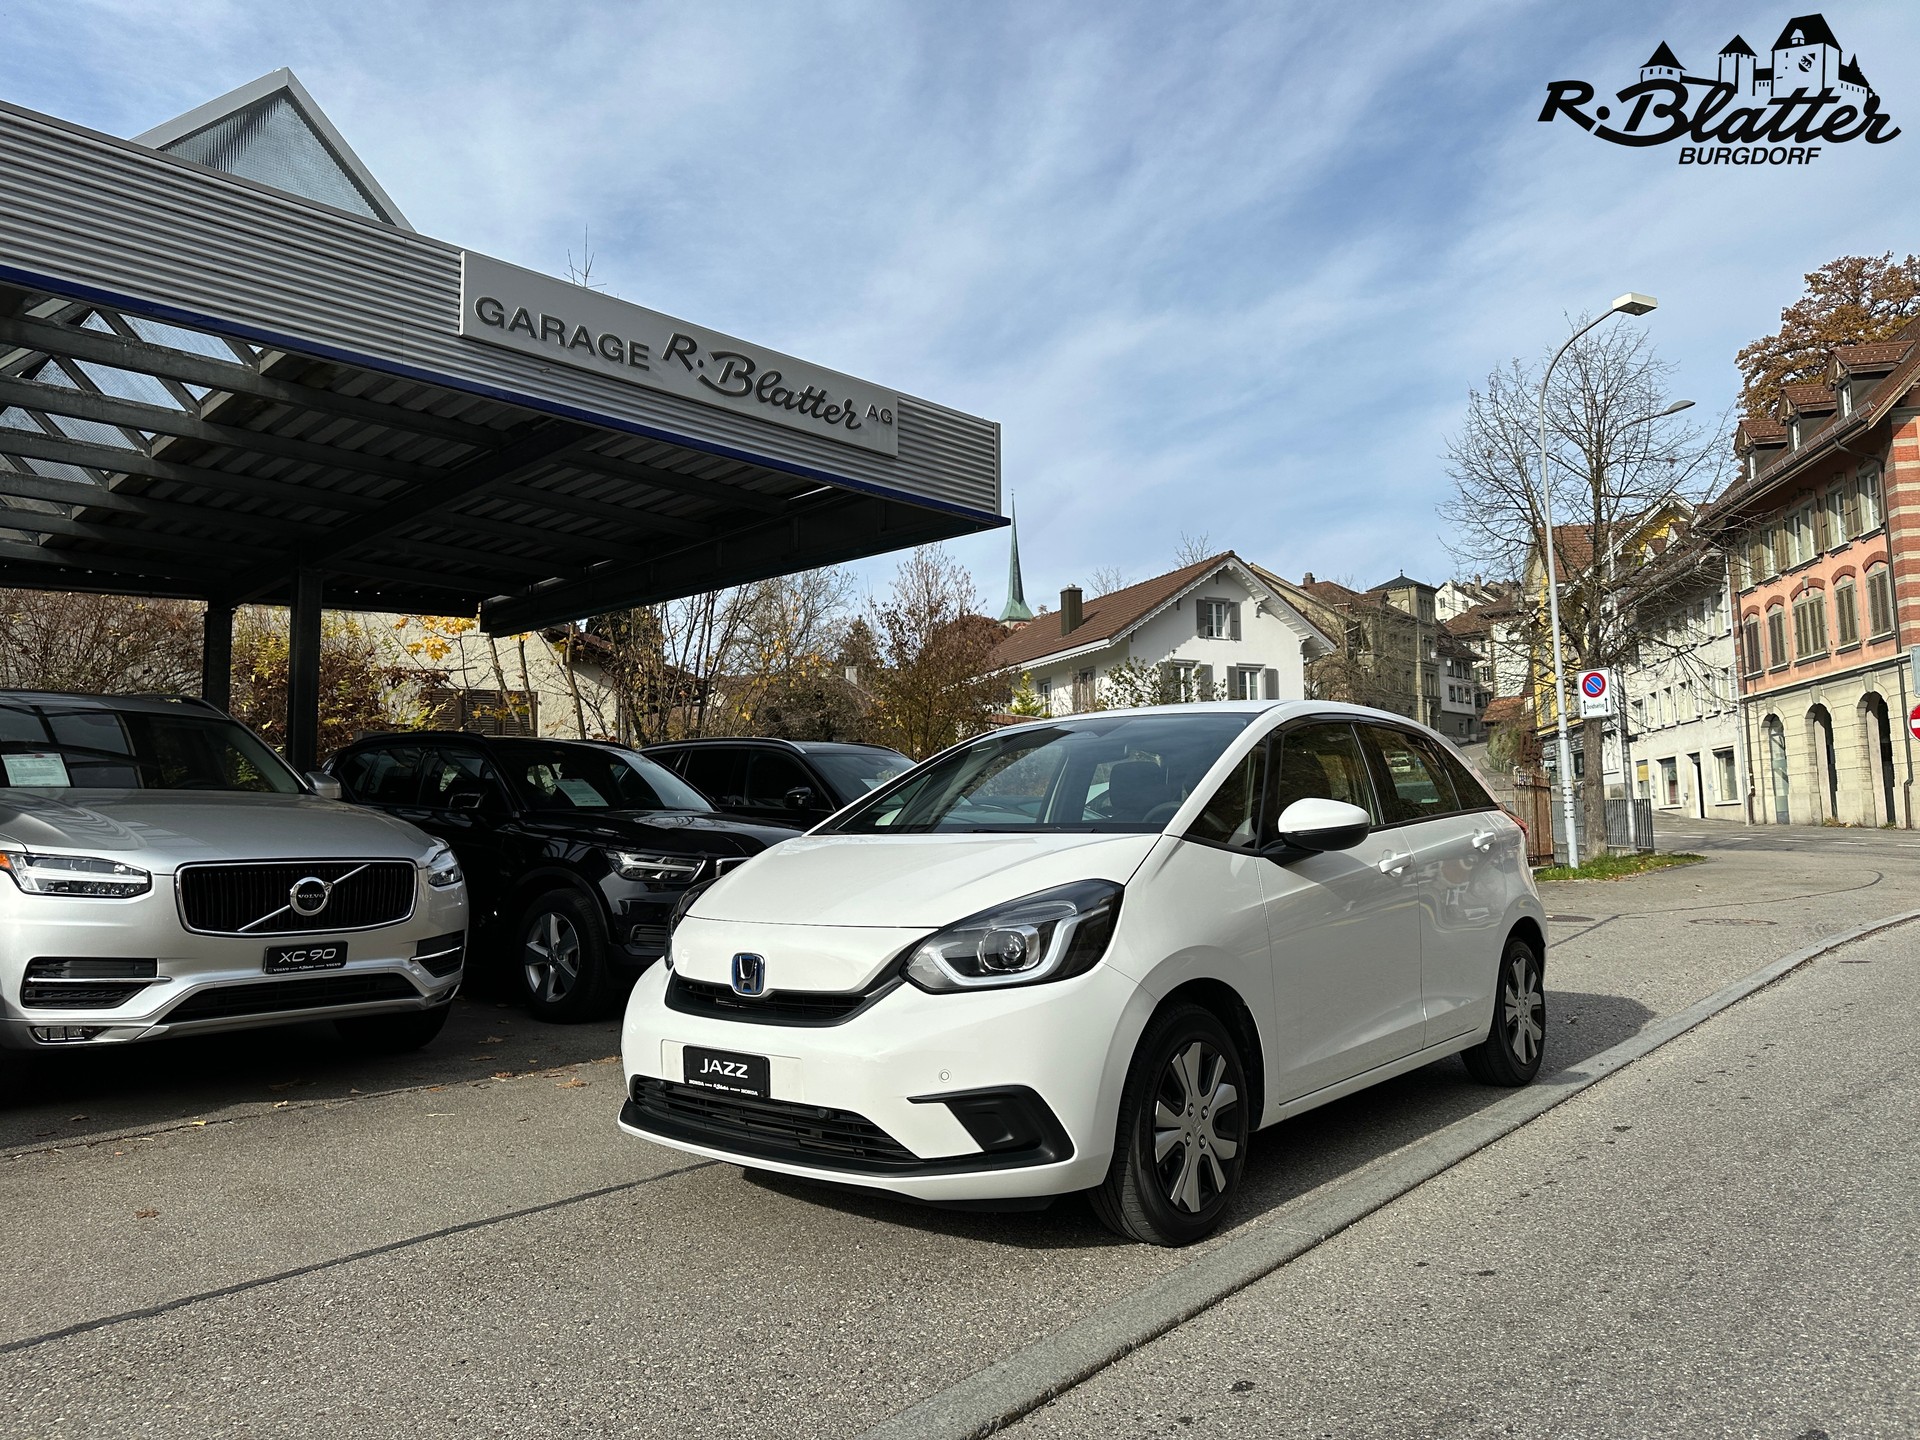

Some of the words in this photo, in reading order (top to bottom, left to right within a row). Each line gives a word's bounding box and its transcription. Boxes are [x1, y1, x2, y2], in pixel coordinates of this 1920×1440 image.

[474, 296, 651, 372] GARAGE
[865, 403, 894, 426] AG
[700, 1058, 748, 1079] JAZZ
